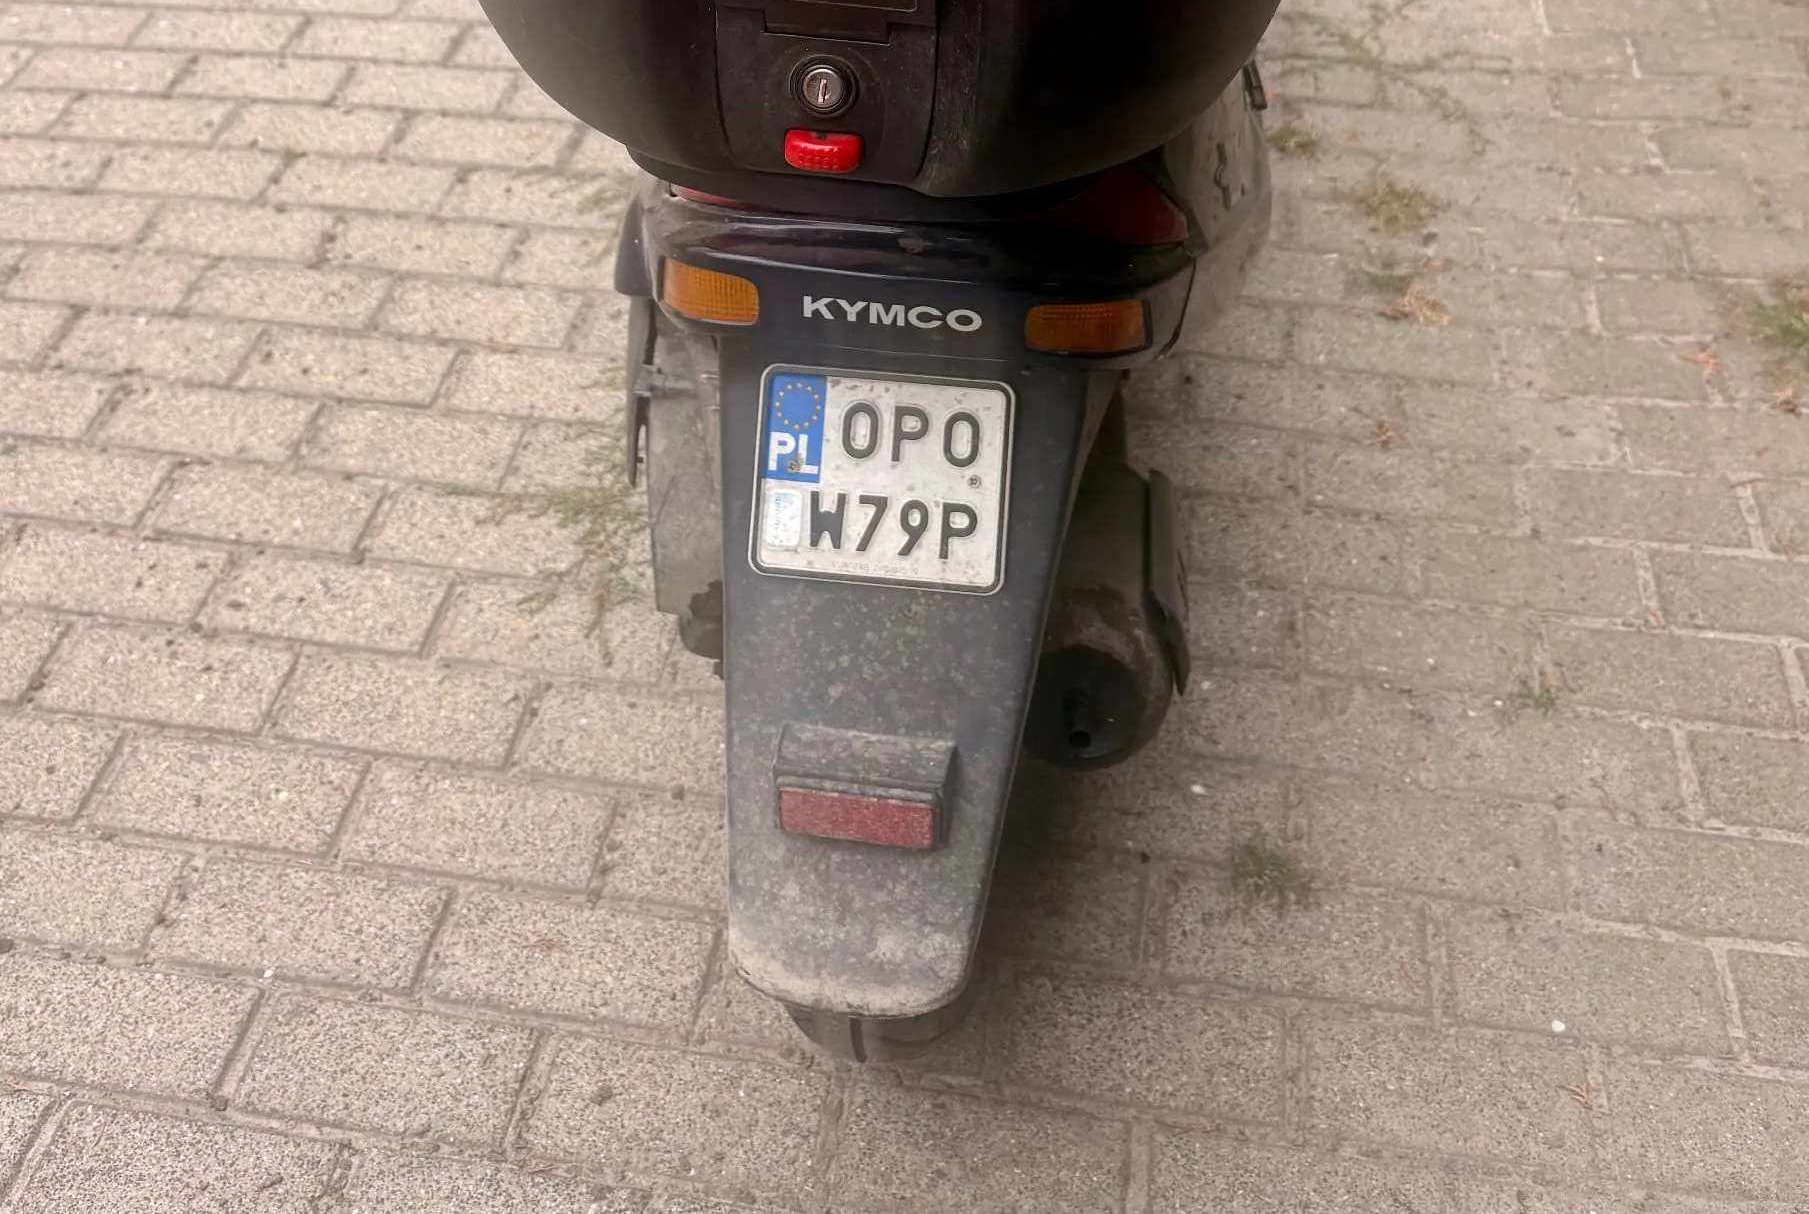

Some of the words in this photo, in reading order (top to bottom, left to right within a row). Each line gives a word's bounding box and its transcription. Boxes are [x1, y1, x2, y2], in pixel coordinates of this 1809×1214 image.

[803, 295, 982, 332] KYMCO
[767, 432, 819, 474] PL
[841, 402, 981, 468] OPO
[808, 490, 979, 560] W79P
